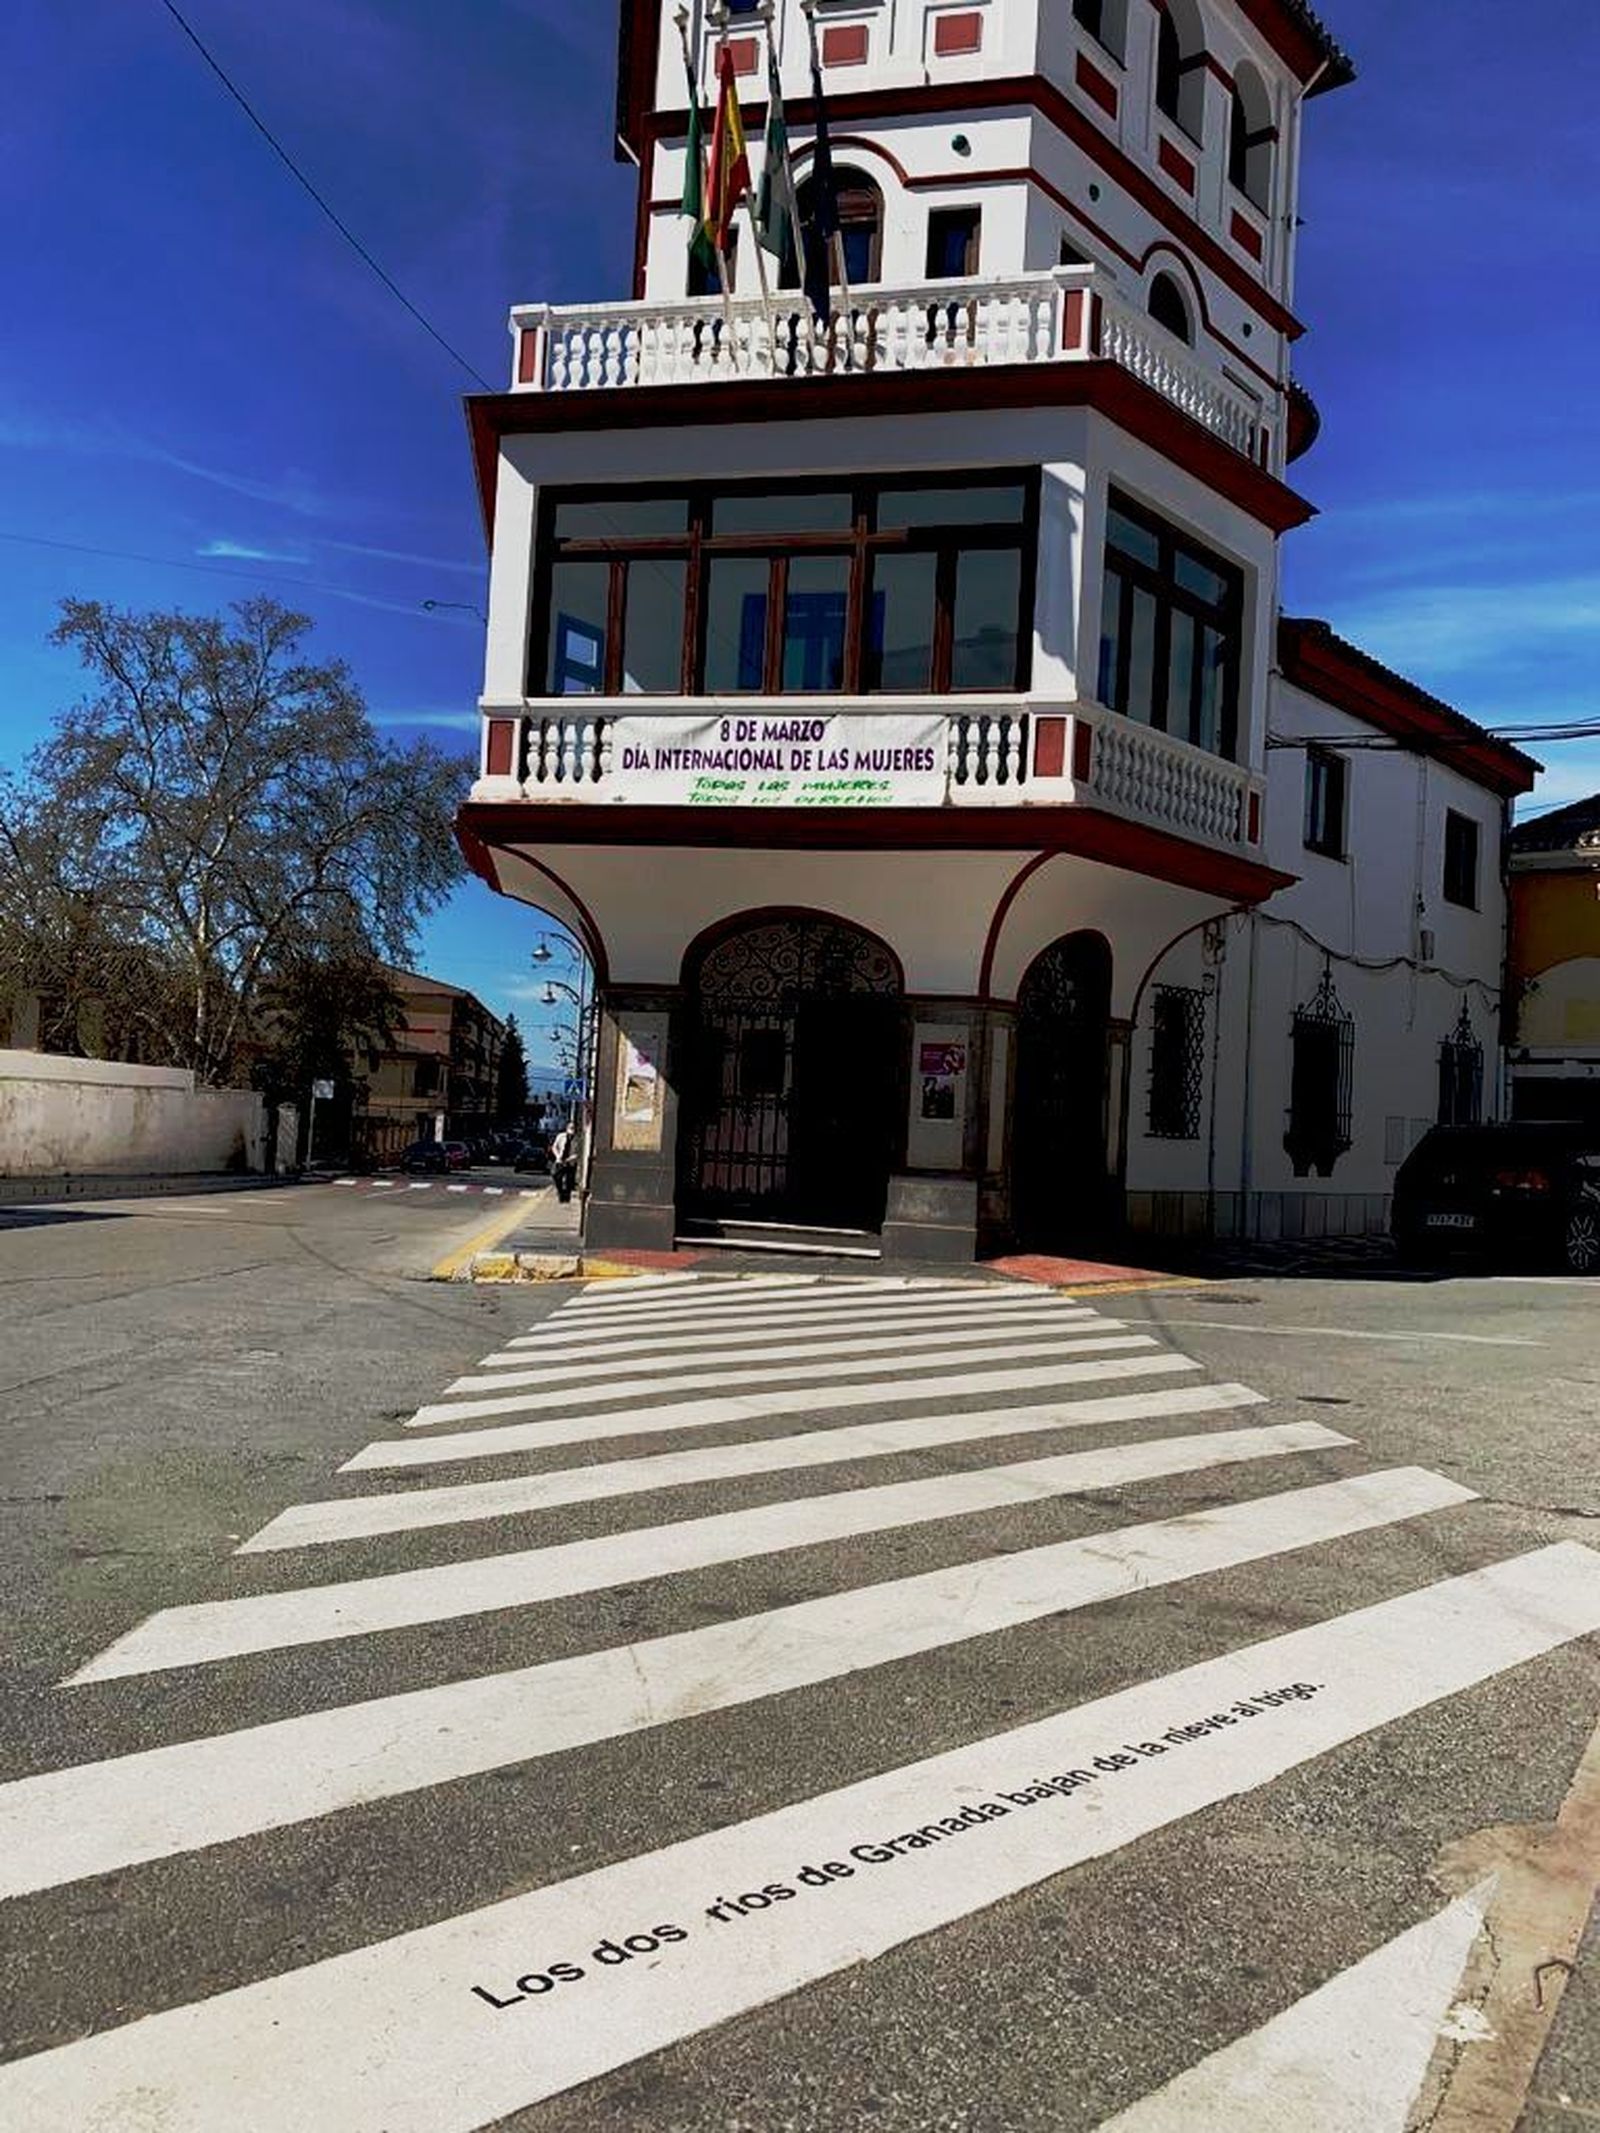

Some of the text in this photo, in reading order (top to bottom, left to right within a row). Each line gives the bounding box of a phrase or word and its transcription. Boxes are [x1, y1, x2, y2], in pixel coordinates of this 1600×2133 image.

[720, 720, 825, 742] 8 DE MARZO
[622, 743, 935, 772] DÍA INTERNACIONAL DE LAS MUJERES
[470, 1963, 586, 2009] Los
[592, 1924, 688, 1965] dos
[796, 1861, 855, 1887] de
[849, 1802, 1013, 1865] Granada
[995, 1769, 1099, 1807] bajan
[1092, 1755, 1139, 1772] de
[1122, 1743, 1170, 1757] la
[1160, 1713, 1239, 1745] nieve
[1230, 1700, 1265, 1717] al
[1249, 1682, 1326, 1707] trigo.
